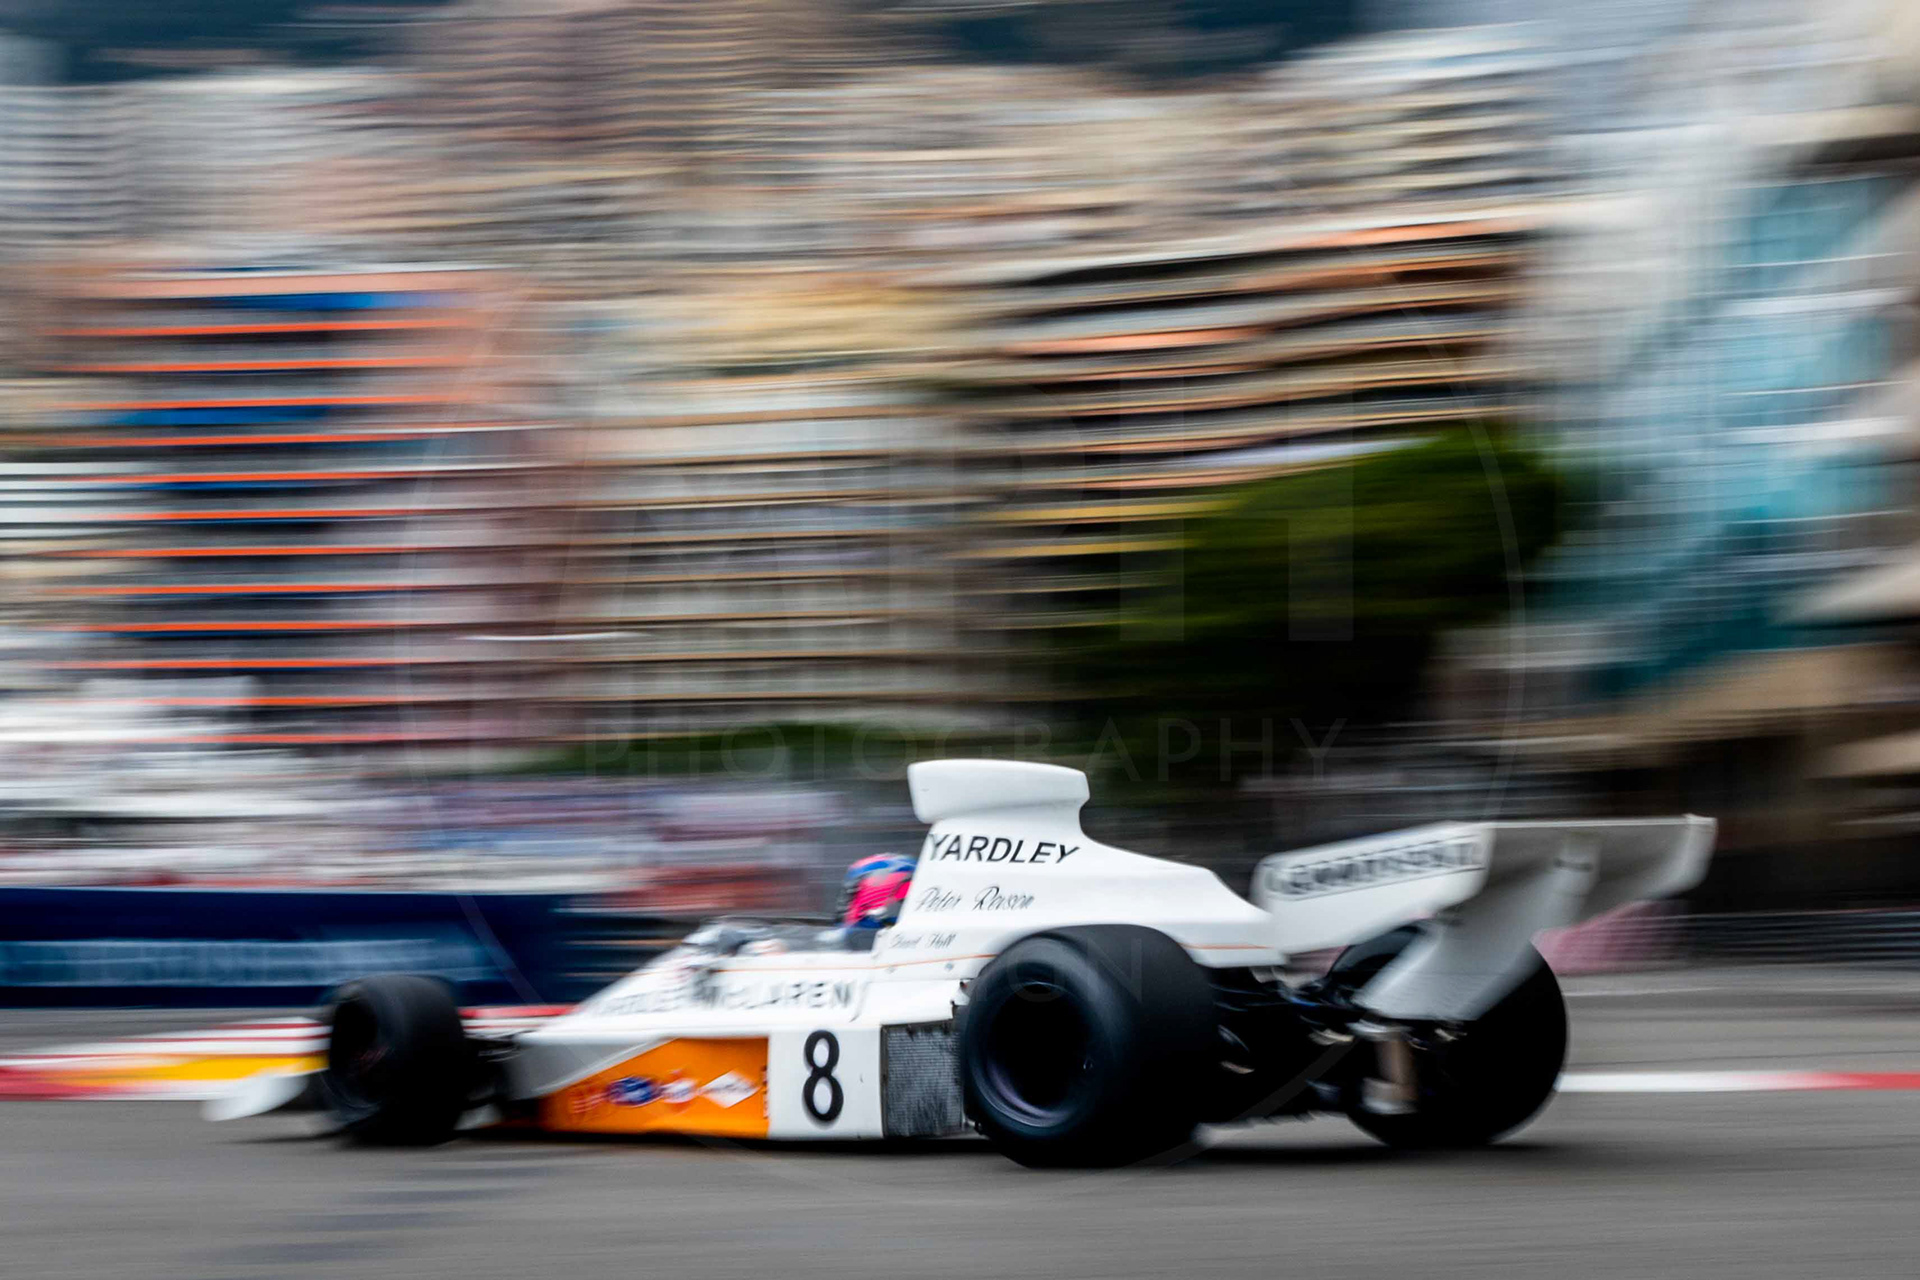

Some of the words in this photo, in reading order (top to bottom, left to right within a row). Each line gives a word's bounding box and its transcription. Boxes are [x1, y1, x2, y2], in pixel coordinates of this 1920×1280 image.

[928, 833, 1079, 864] YARDLEY
[915, 886, 962, 912] Peter
[802, 1029, 844, 1124] 8
